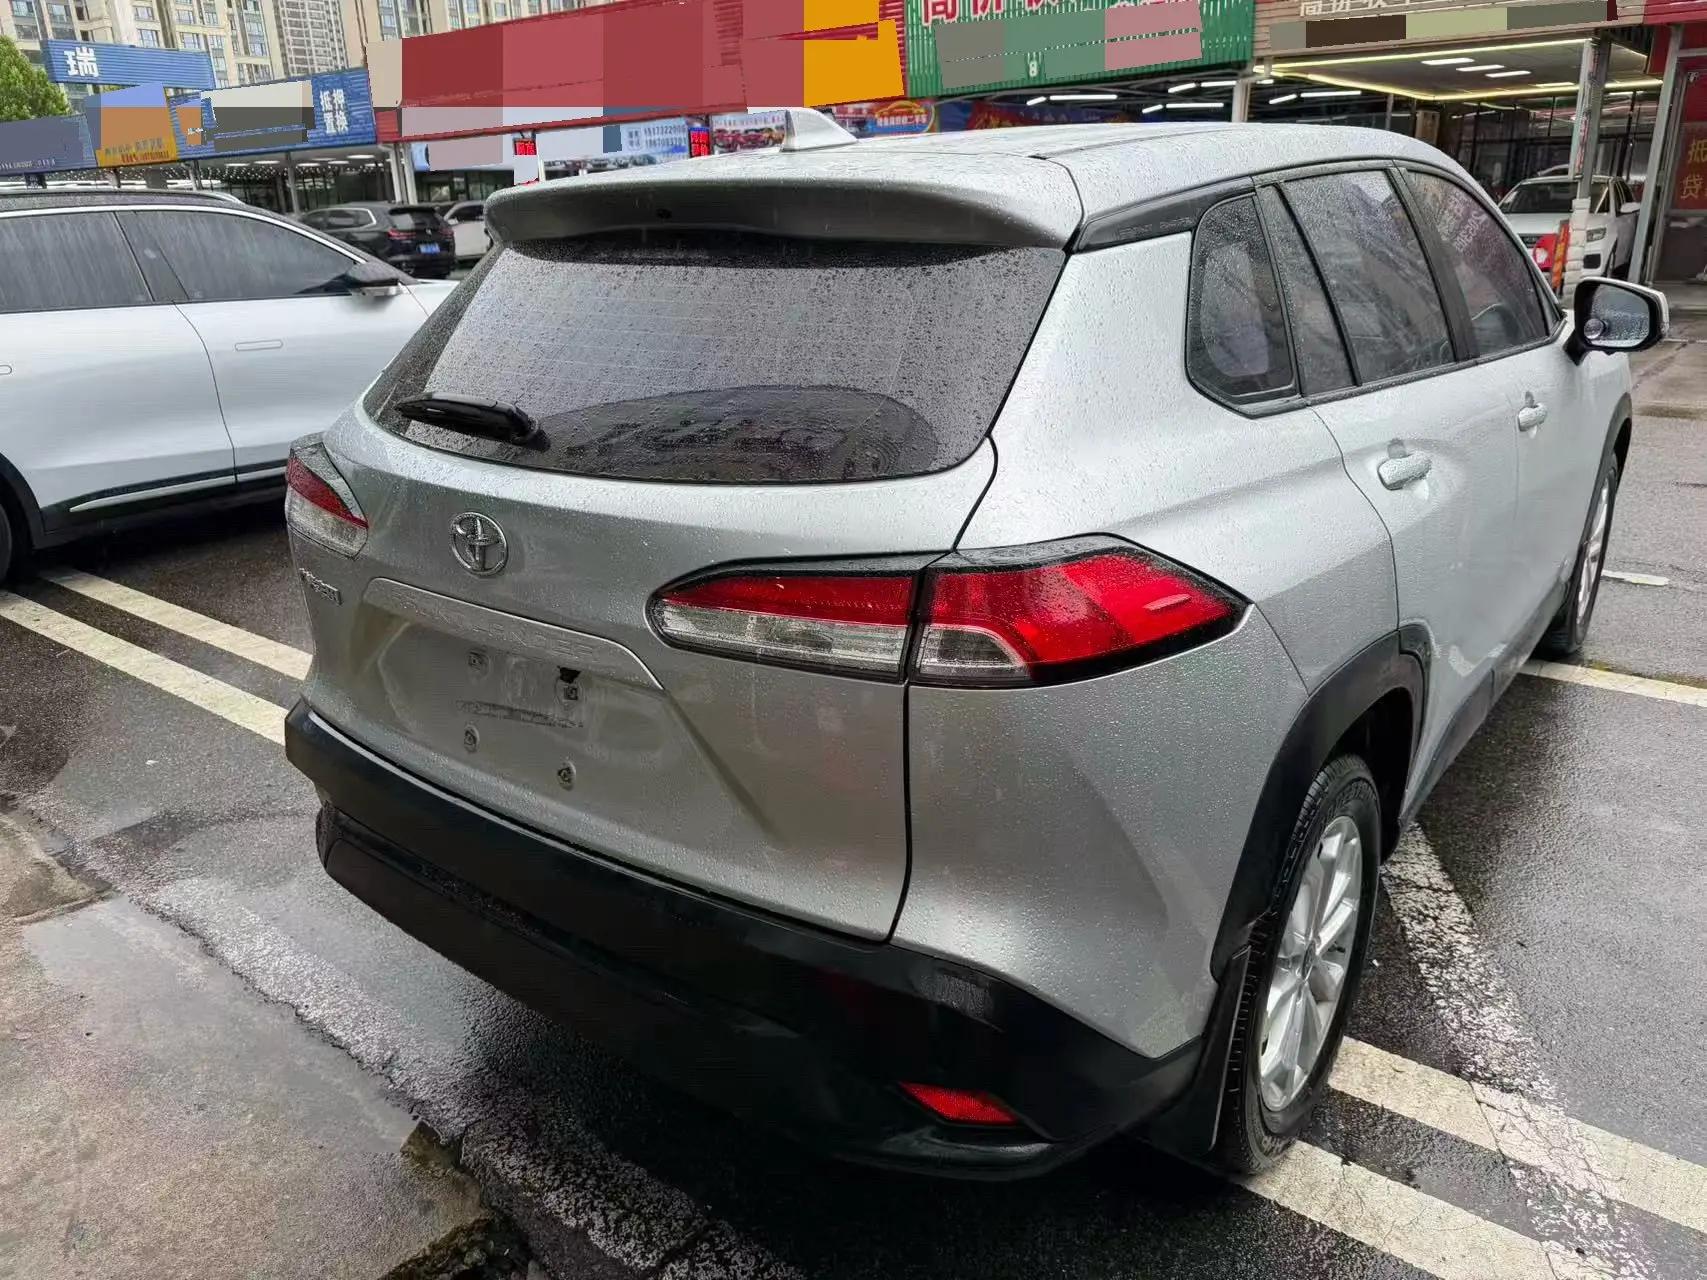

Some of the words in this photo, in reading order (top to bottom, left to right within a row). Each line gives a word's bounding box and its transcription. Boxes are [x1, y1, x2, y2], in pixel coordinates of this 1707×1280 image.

[63, 46, 99, 78] 瑞
[319, 88, 345, 113] 抵押
[323, 110, 349, 135] 置换
